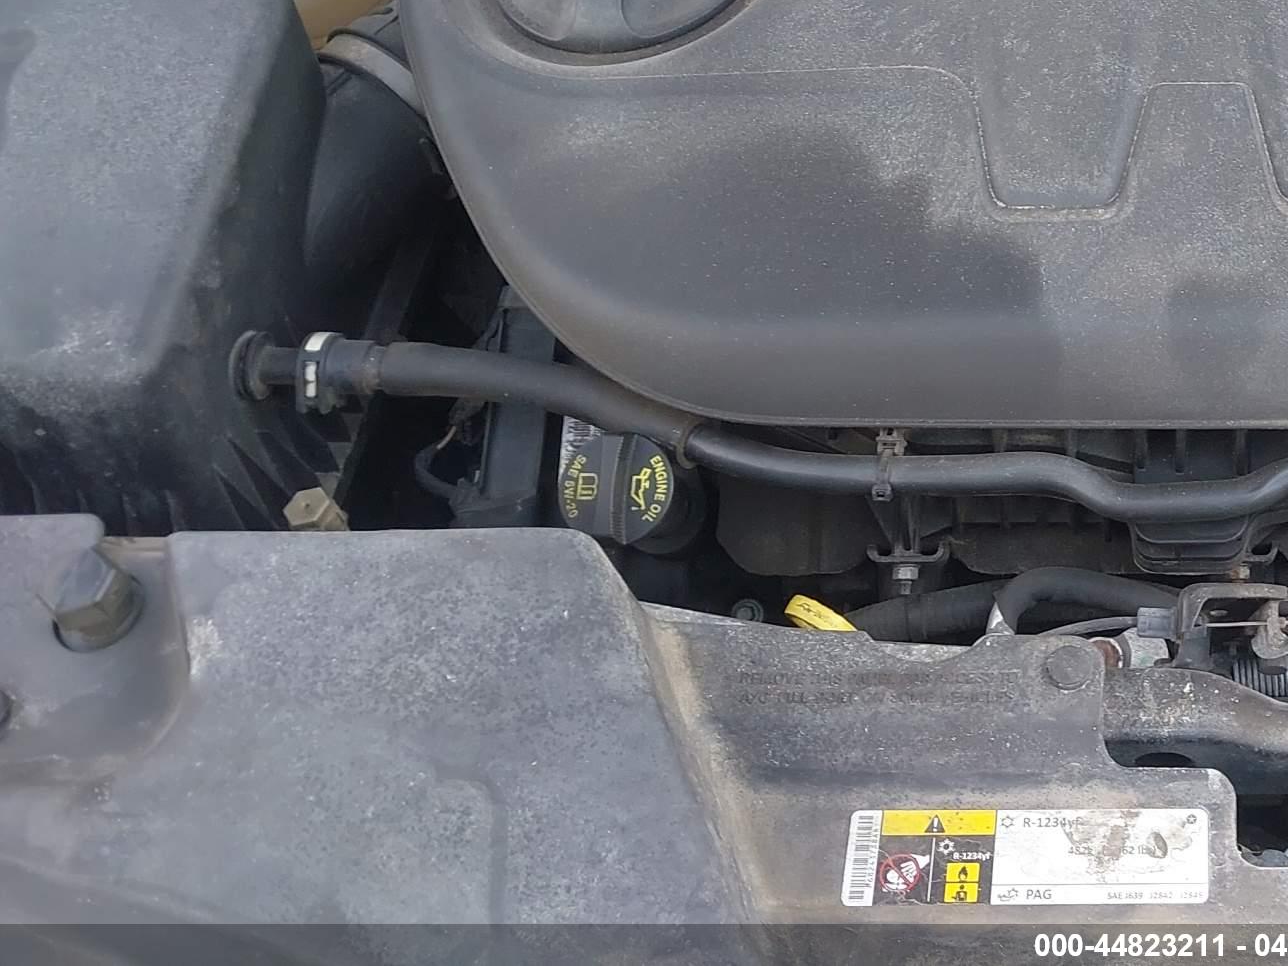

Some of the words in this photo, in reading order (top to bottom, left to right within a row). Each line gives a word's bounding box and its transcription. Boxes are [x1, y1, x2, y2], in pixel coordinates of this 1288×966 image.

[567, 454, 587, 478] SAE
[649, 455, 668, 501] ENGINE
[641, 503, 662, 522] OIL
[1023, 816, 1081, 830] R-1234yf
[952, 851, 991, 861] R-1234yf
[1025, 889, 1053, 901] PAG
